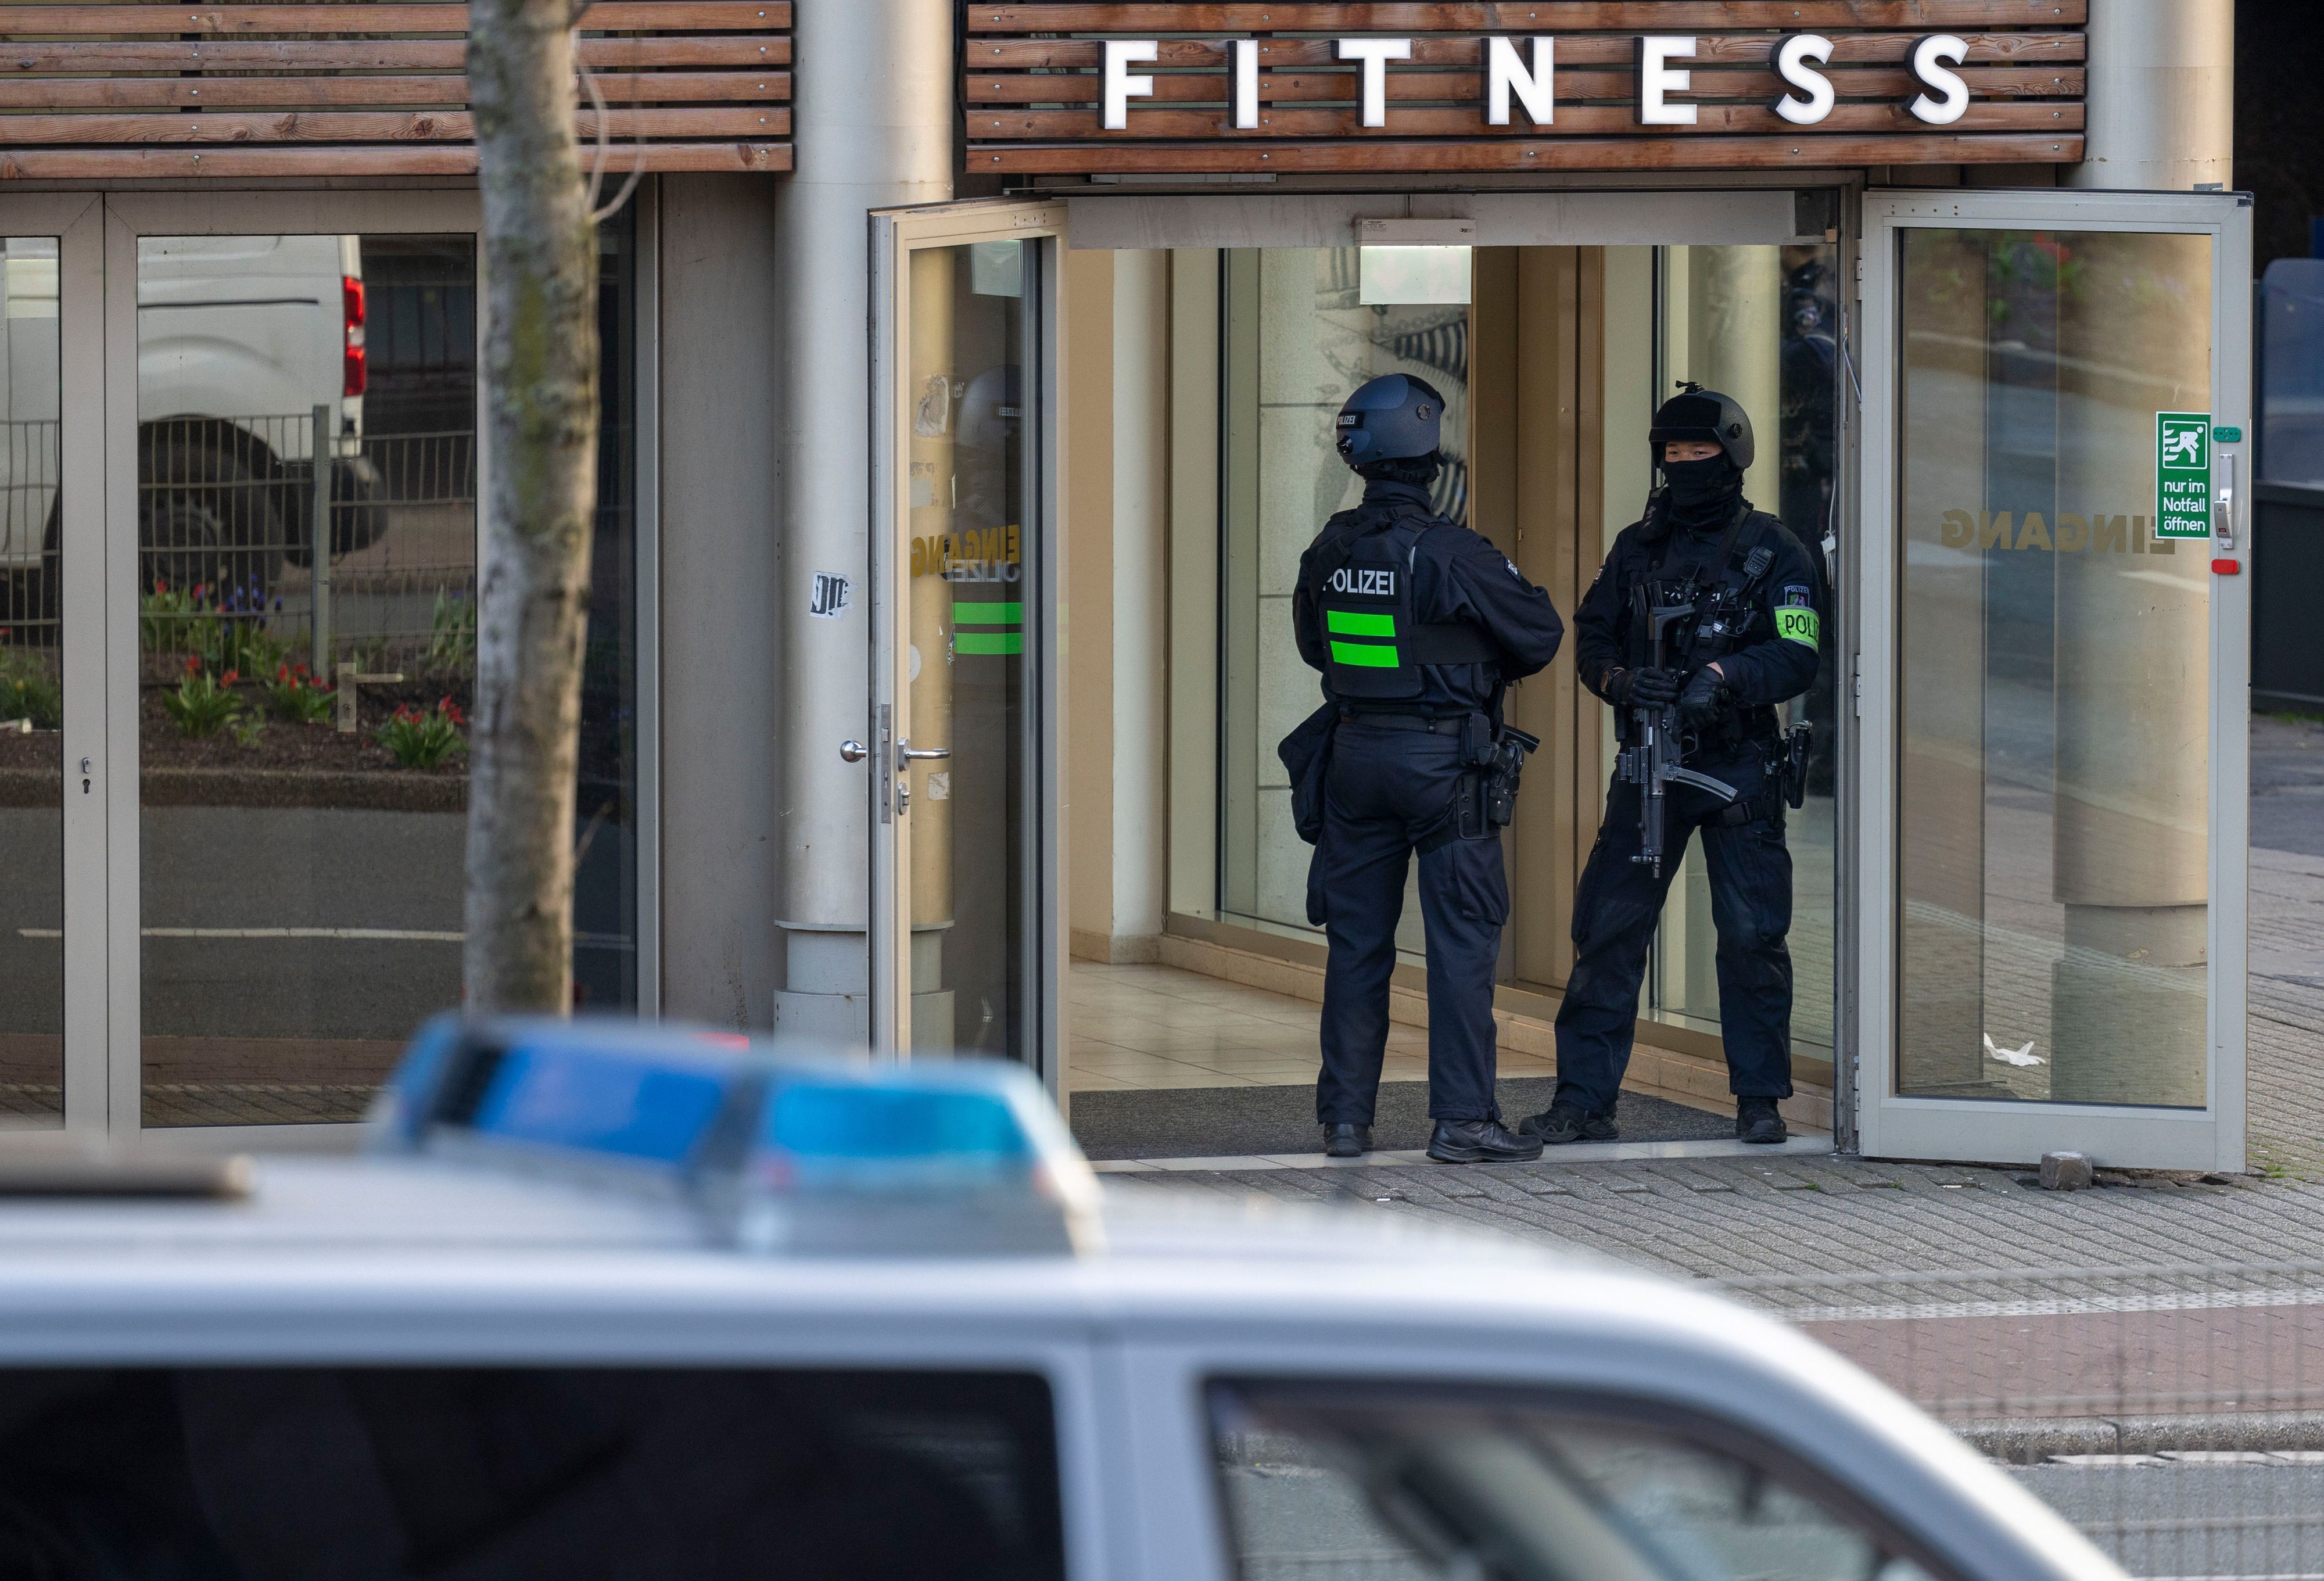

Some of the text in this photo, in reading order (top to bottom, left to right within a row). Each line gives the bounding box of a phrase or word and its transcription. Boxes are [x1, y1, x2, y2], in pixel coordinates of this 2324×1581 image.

[1099, 35, 1969, 129] FITNESS
[2164, 478, 2205, 493] nur im
[2163, 497, 2206, 512] Notfall
[2164, 516, 2206, 532] öffnen
